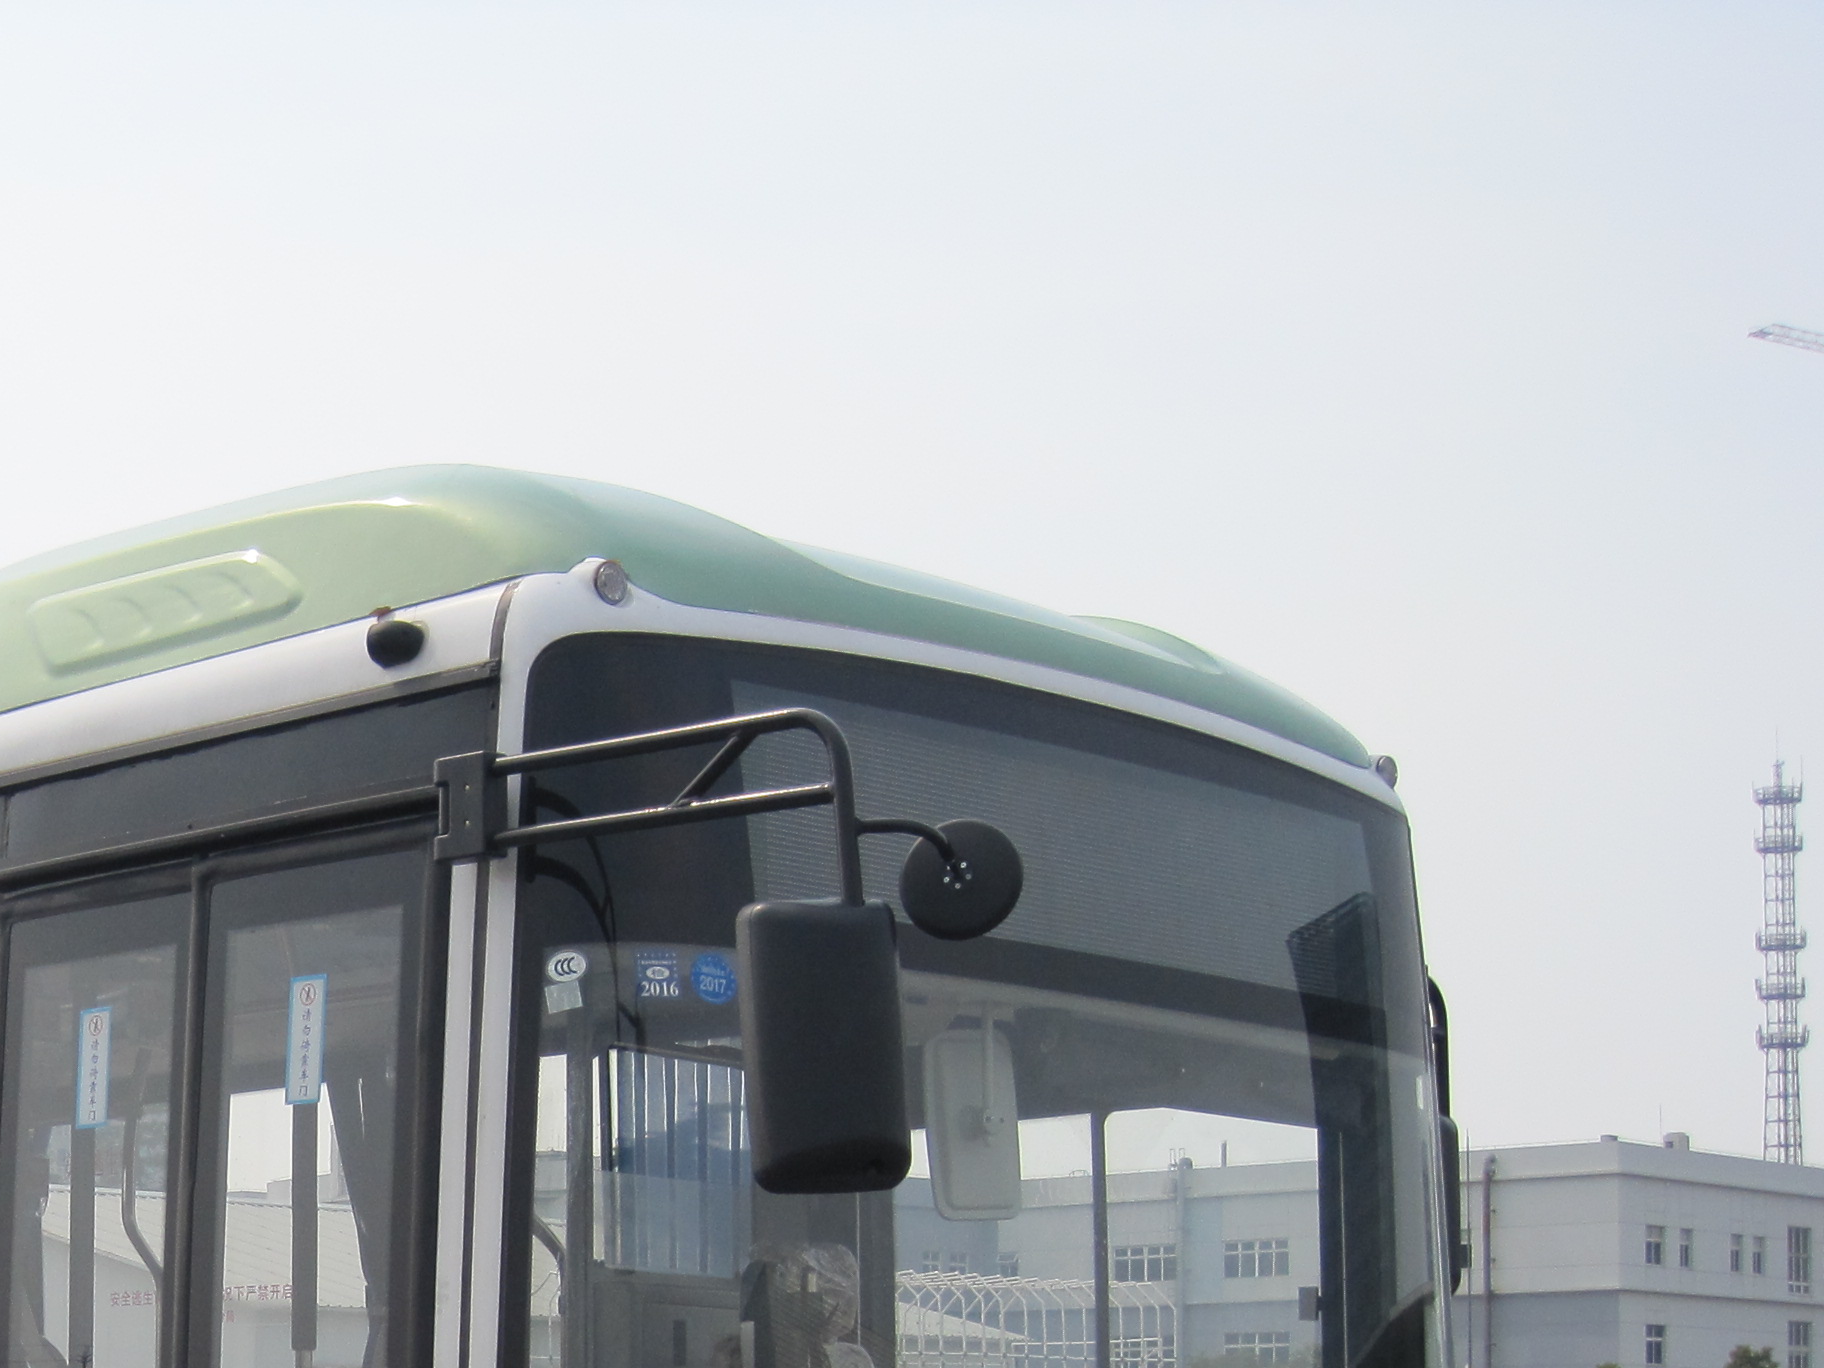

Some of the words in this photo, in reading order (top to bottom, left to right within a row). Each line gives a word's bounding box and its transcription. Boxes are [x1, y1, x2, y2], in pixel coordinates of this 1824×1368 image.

[554, 956, 578, 976] CCC
[641, 981, 679, 997] 2016
[699, 975, 727, 994] 2017
